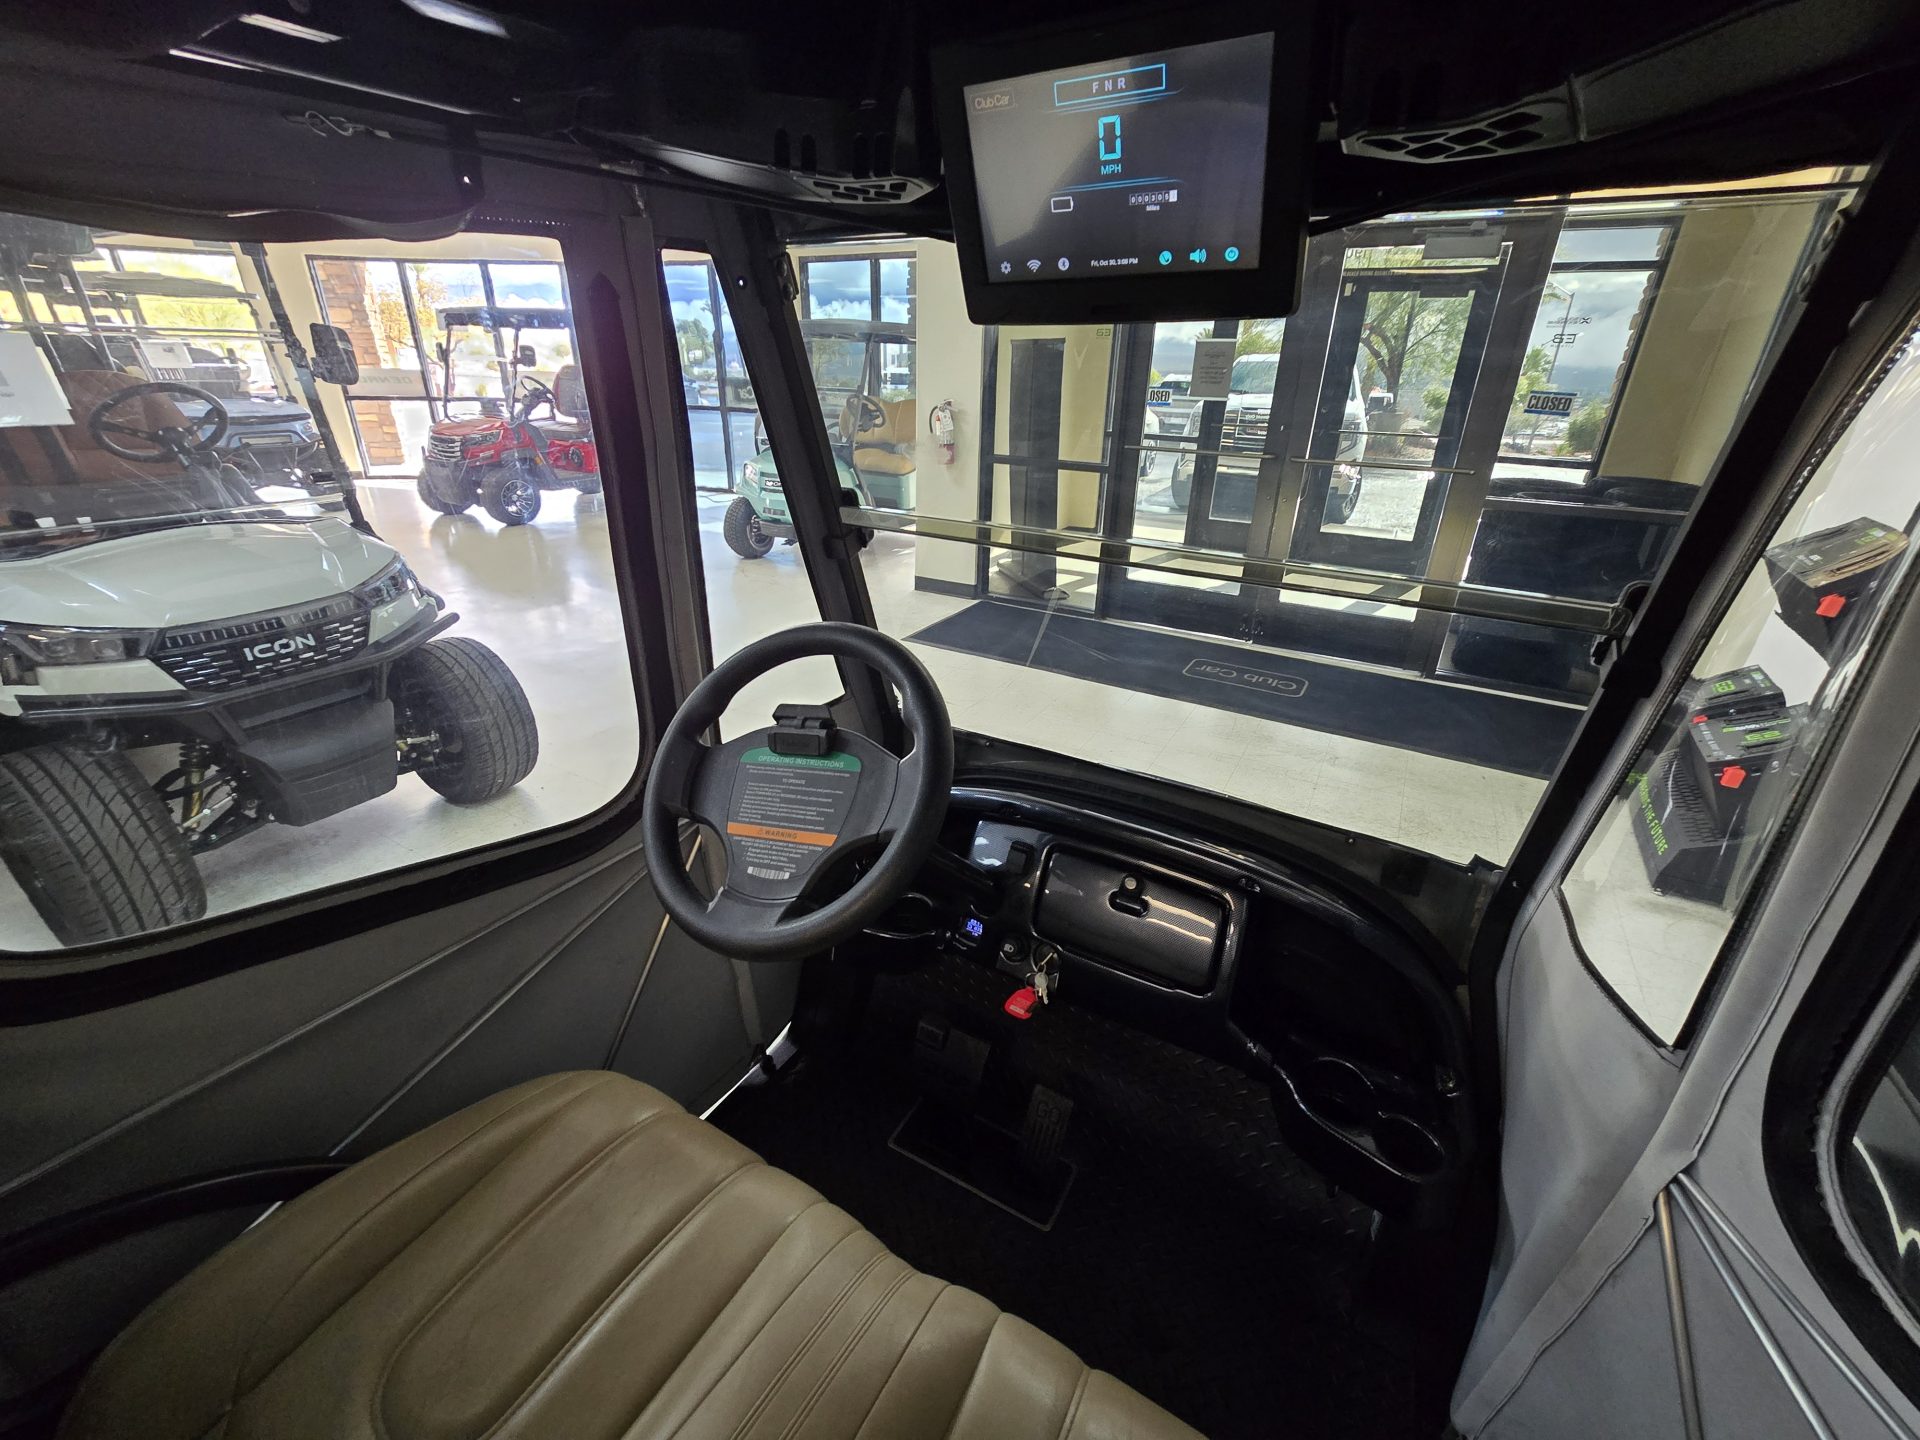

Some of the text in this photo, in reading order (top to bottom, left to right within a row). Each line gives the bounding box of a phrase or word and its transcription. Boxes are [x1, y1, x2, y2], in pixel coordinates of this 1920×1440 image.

[1098, 115, 1122, 161] 0
[1101, 164, 1122, 175] MPH
[1148, 389, 1172, 402] OSED
[1527, 394, 1573, 412] CLOSED
[243, 633, 316, 662] ICON
[1194, 664, 1297, 690] Club Car
[758, 755, 845, 769] OPERATING INSTRUCTIONS
[764, 829, 798, 840] WARNING
[1648, 820, 1669, 855] FUTURE
